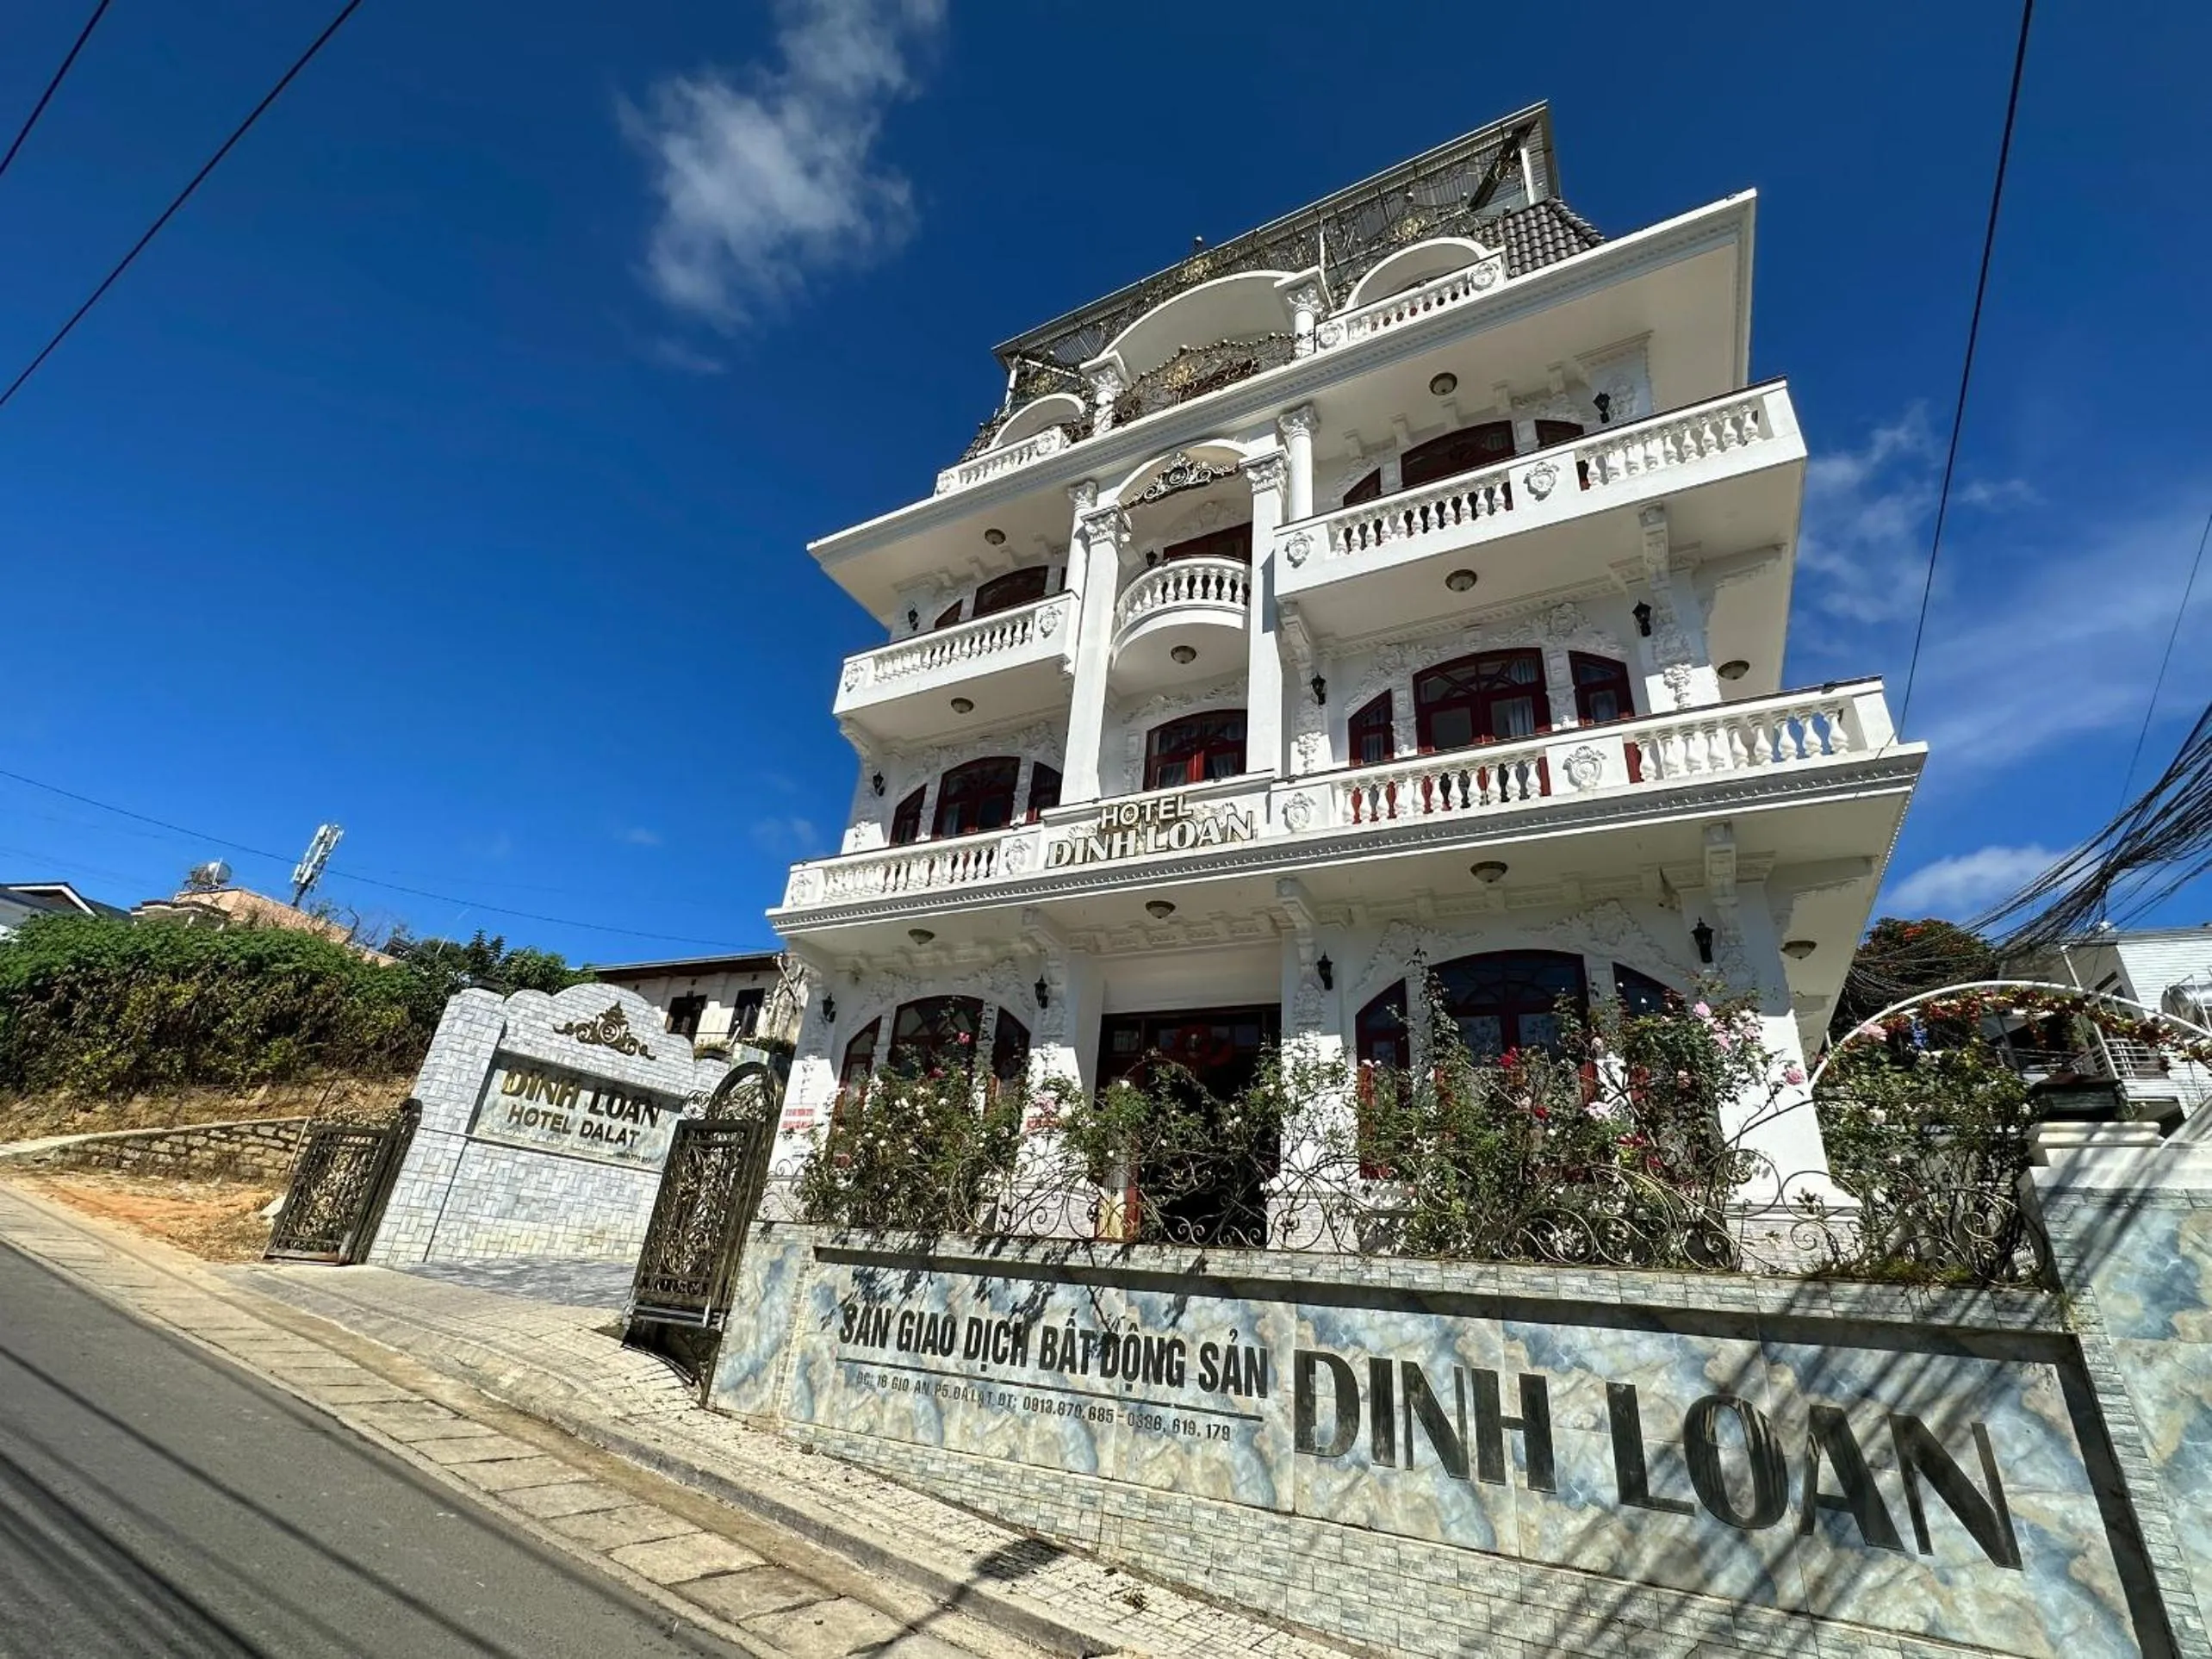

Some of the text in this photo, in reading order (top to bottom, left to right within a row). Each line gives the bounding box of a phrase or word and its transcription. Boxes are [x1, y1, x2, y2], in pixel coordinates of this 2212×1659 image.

[1047, 811, 1254, 868] DINH LOAN
[1101, 795, 1194, 830] HOTEL
[501, 1067, 661, 1128] DINH LOAN
[507, 1104, 572, 1135] HOTEL
[579, 1121, 640, 1147] DALAT
[897, 1309, 957, 1357] GIAO
[963, 1316, 1031, 1371] DỊCH
[1038, 1308, 1095, 1376] BẤT
[1198, 1328, 1268, 1399] SẢN
[1294, 1349, 2024, 1570] DINH LOAN
